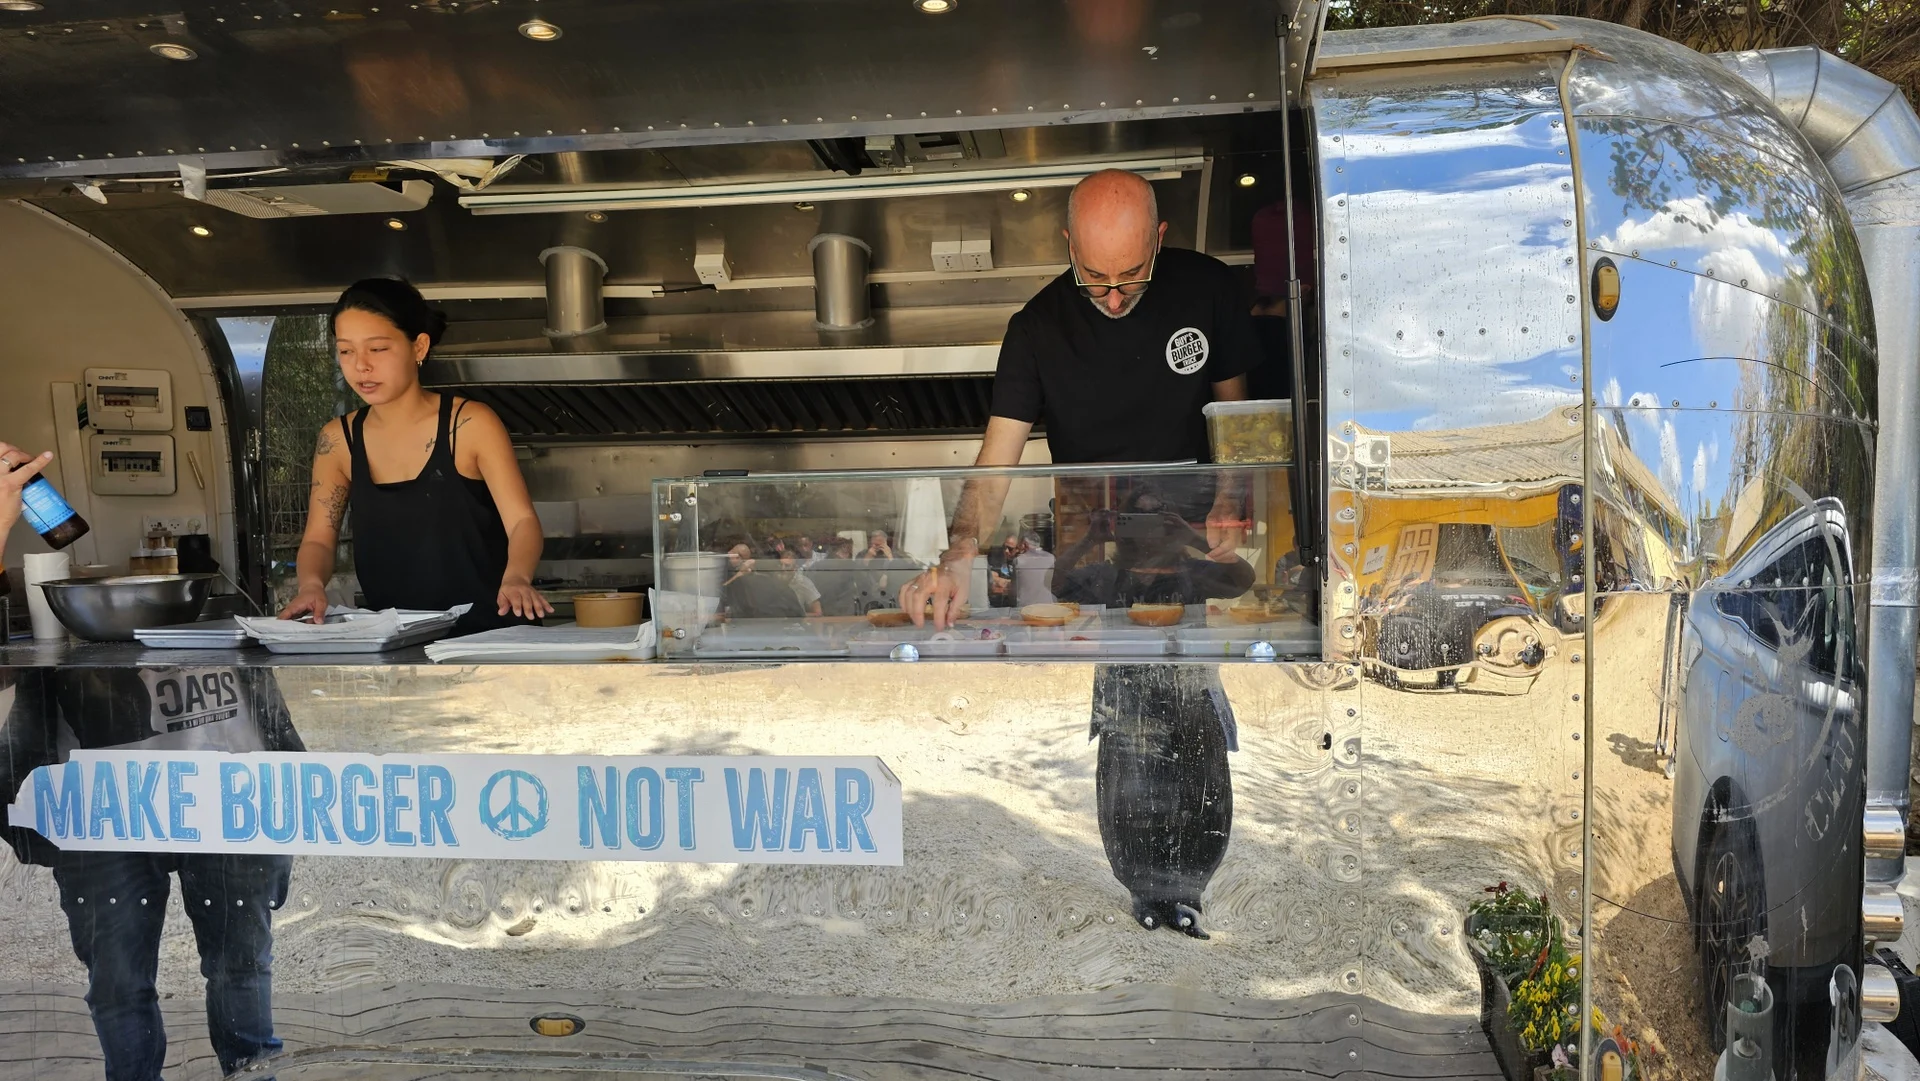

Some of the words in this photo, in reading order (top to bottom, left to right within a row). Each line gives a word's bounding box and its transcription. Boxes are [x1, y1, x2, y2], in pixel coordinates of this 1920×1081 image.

[1174, 332, 1194, 347] GUY'S
[1171, 340, 1204, 362] BURGER
[33, 760, 201, 842] MAKE
[219, 762, 460, 847] BURGER
[577, 765, 705, 851] NOT
[723, 767, 878, 854] WAR
